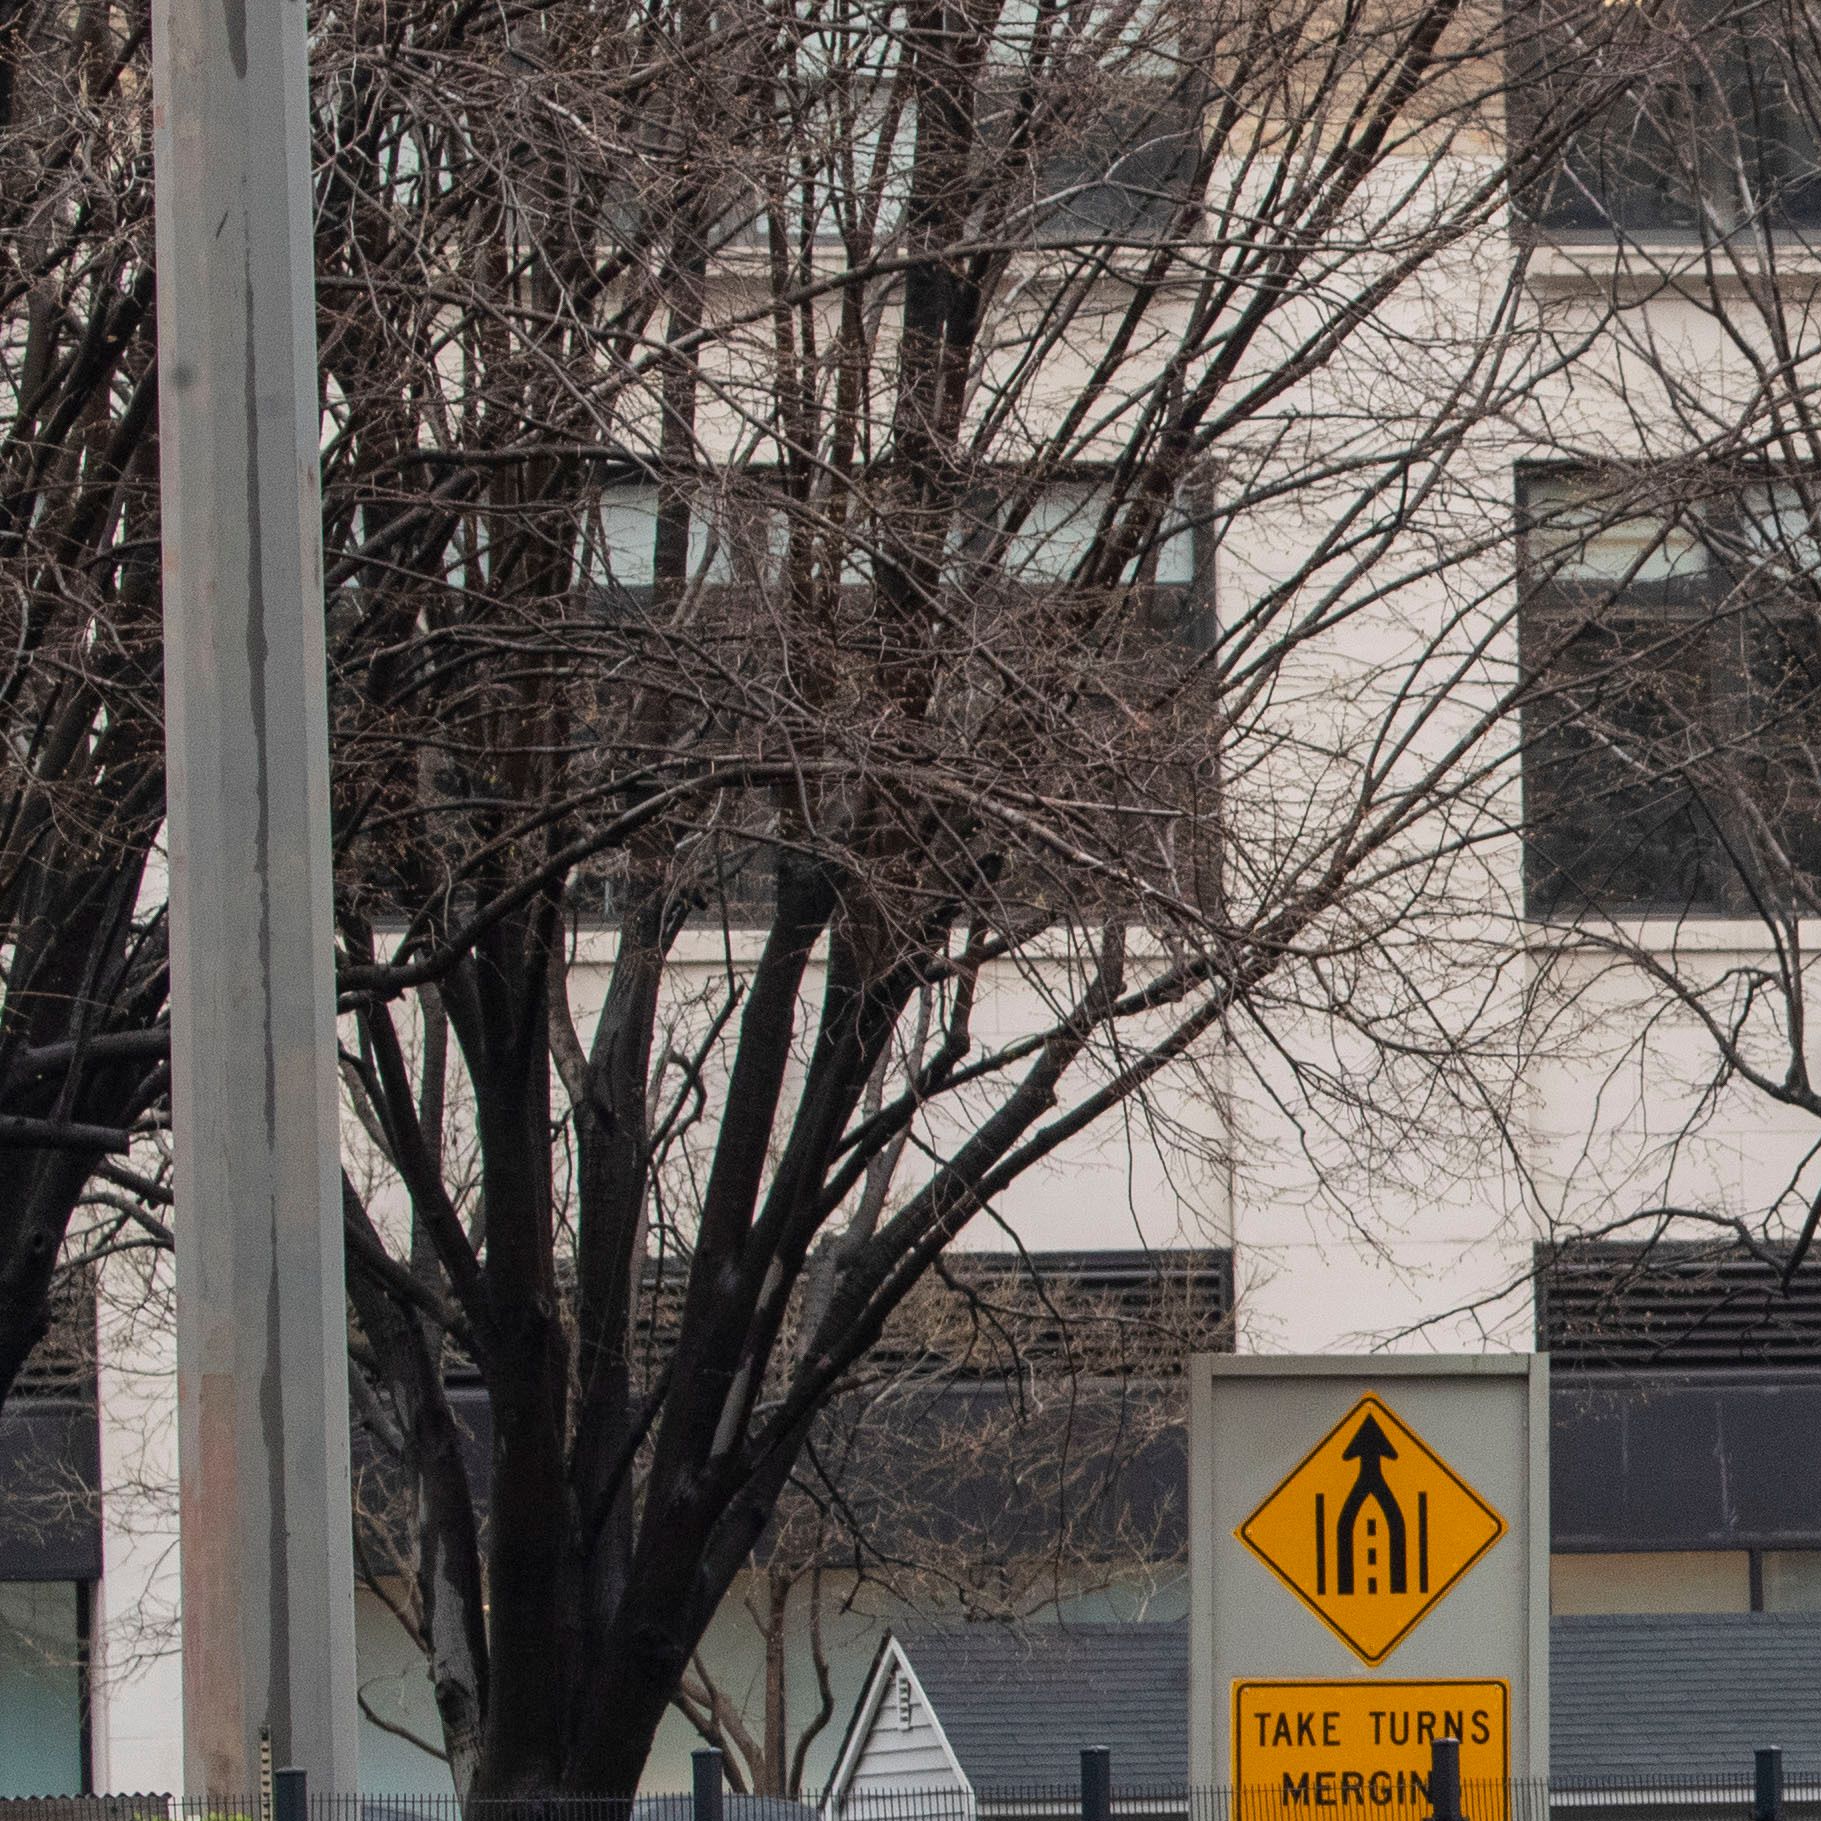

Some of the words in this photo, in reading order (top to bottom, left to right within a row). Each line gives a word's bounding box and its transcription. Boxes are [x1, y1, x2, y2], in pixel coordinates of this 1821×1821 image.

[1254, 1712, 1341, 1748] TAKE
[1369, 1710, 1491, 1745] TURNS
[1282, 1771, 1434, 1807] MERGIN
